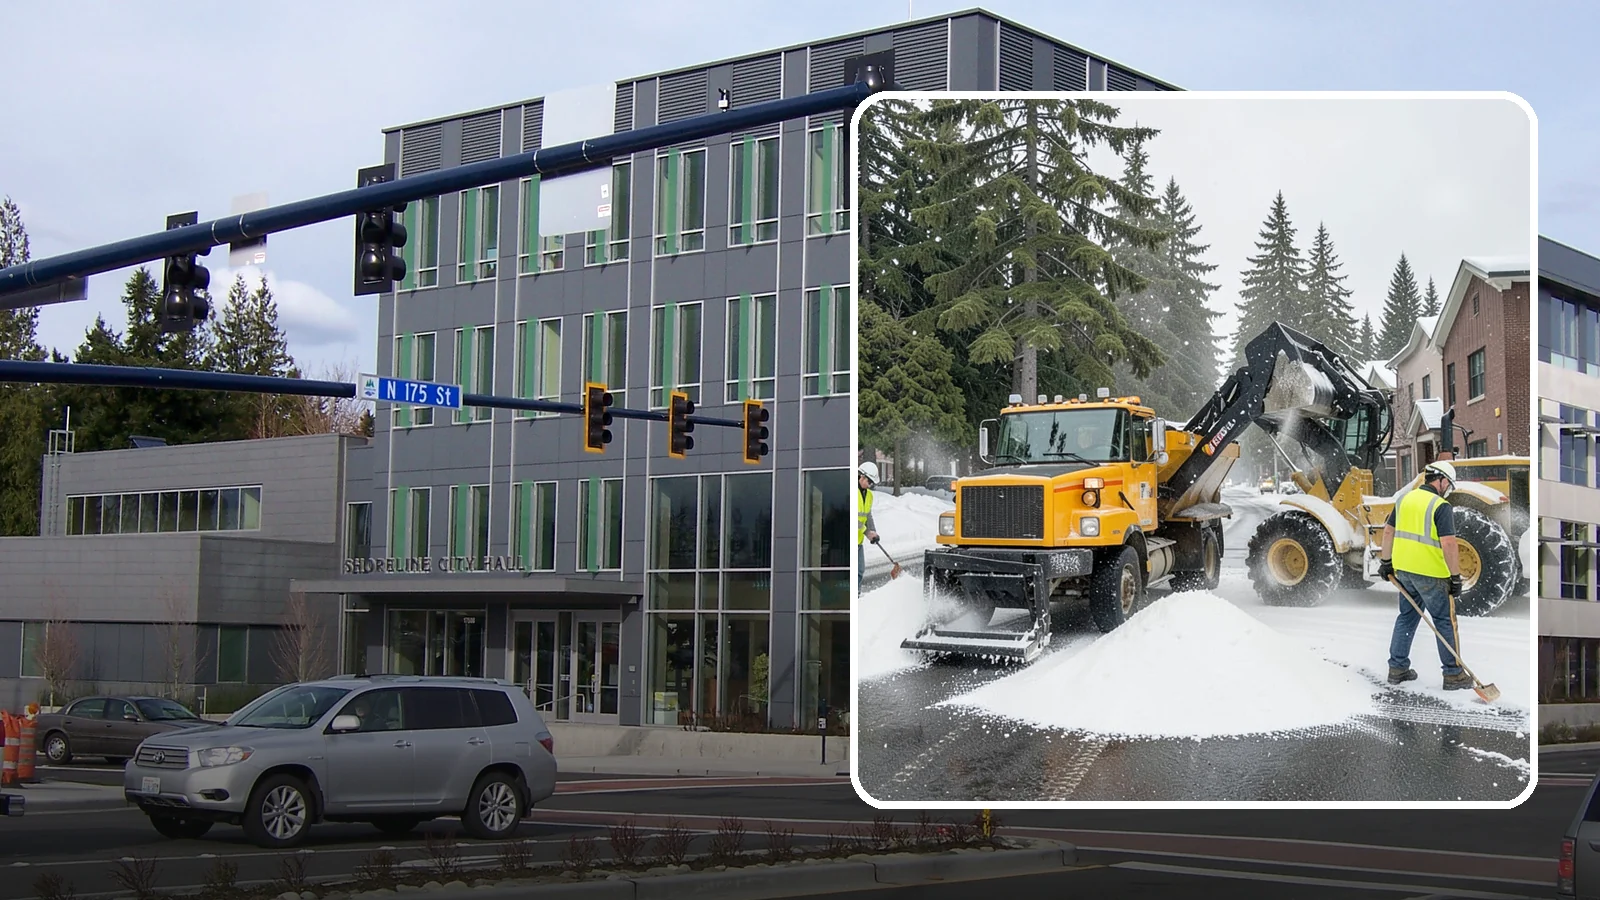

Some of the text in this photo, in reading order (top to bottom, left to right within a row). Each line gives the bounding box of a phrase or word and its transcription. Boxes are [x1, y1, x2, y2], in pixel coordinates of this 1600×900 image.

[387, 380, 451, 405] N 175 St
[344, 555, 526, 574] SHORELINE CITY HALL
